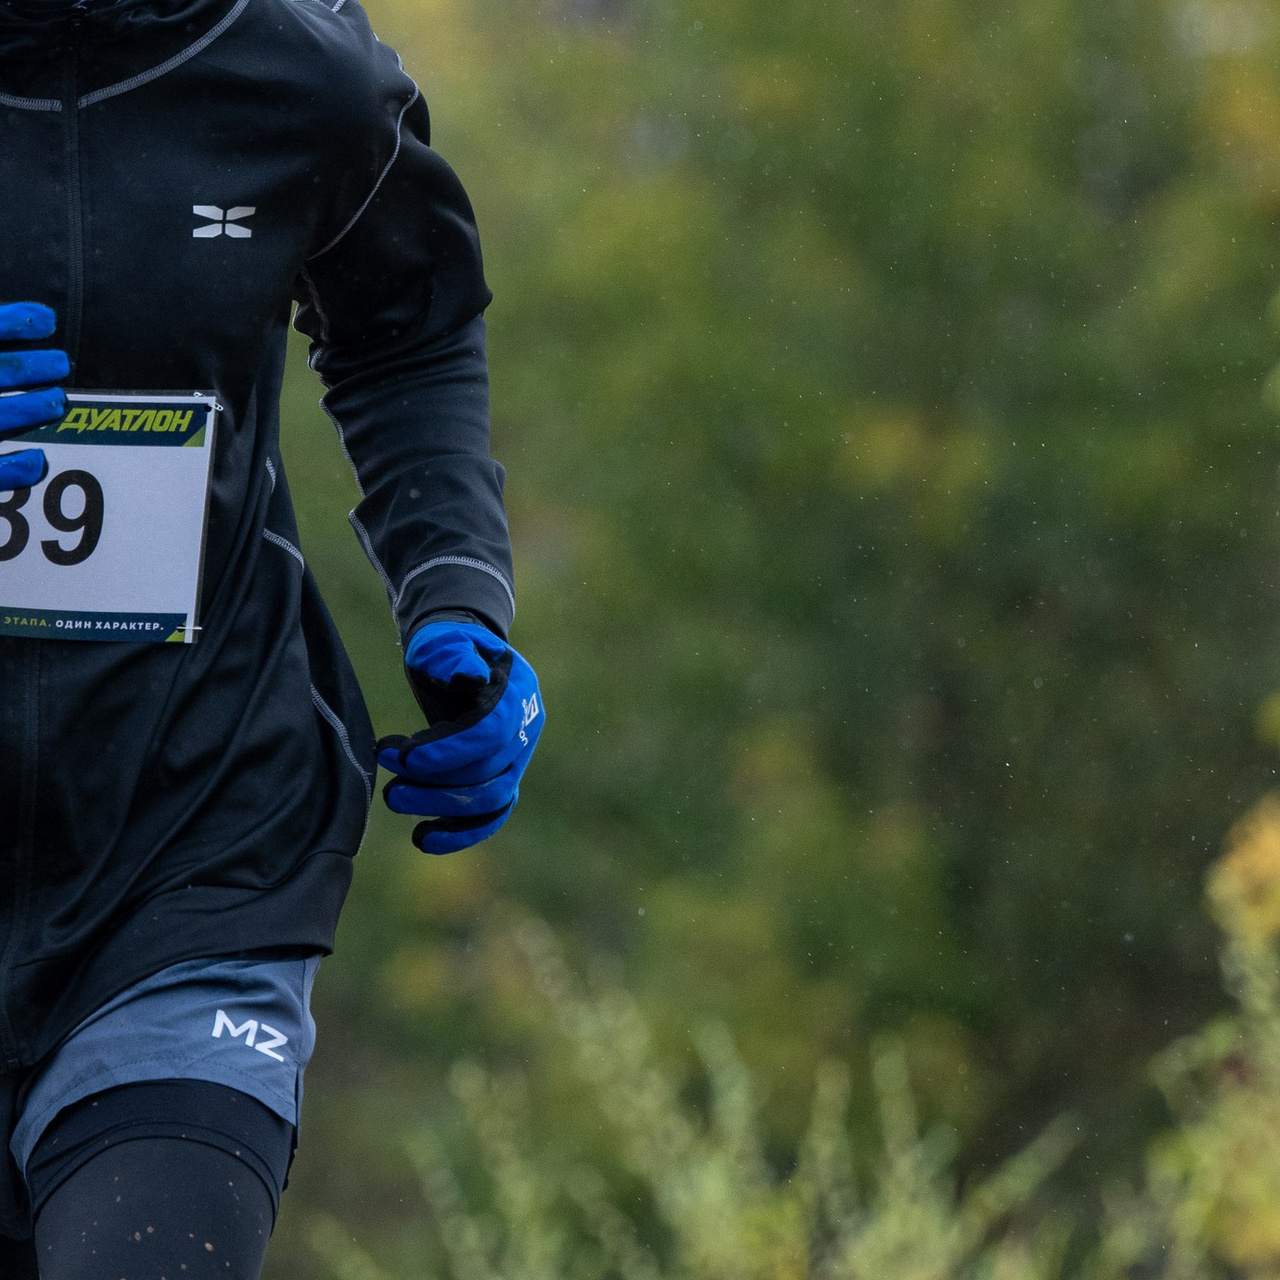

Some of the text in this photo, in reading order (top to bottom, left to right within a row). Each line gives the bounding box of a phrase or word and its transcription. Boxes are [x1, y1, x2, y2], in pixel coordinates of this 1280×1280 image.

[55, 407, 194, 434] ДУАТЛОН
[3, 616, 52, 628] ЭТАПА.
[55, 619, 92, 630] ОДИН
[95, 621, 164, 632] ХАРАКТЕР.
[211, 1009, 288, 1062] MZ
